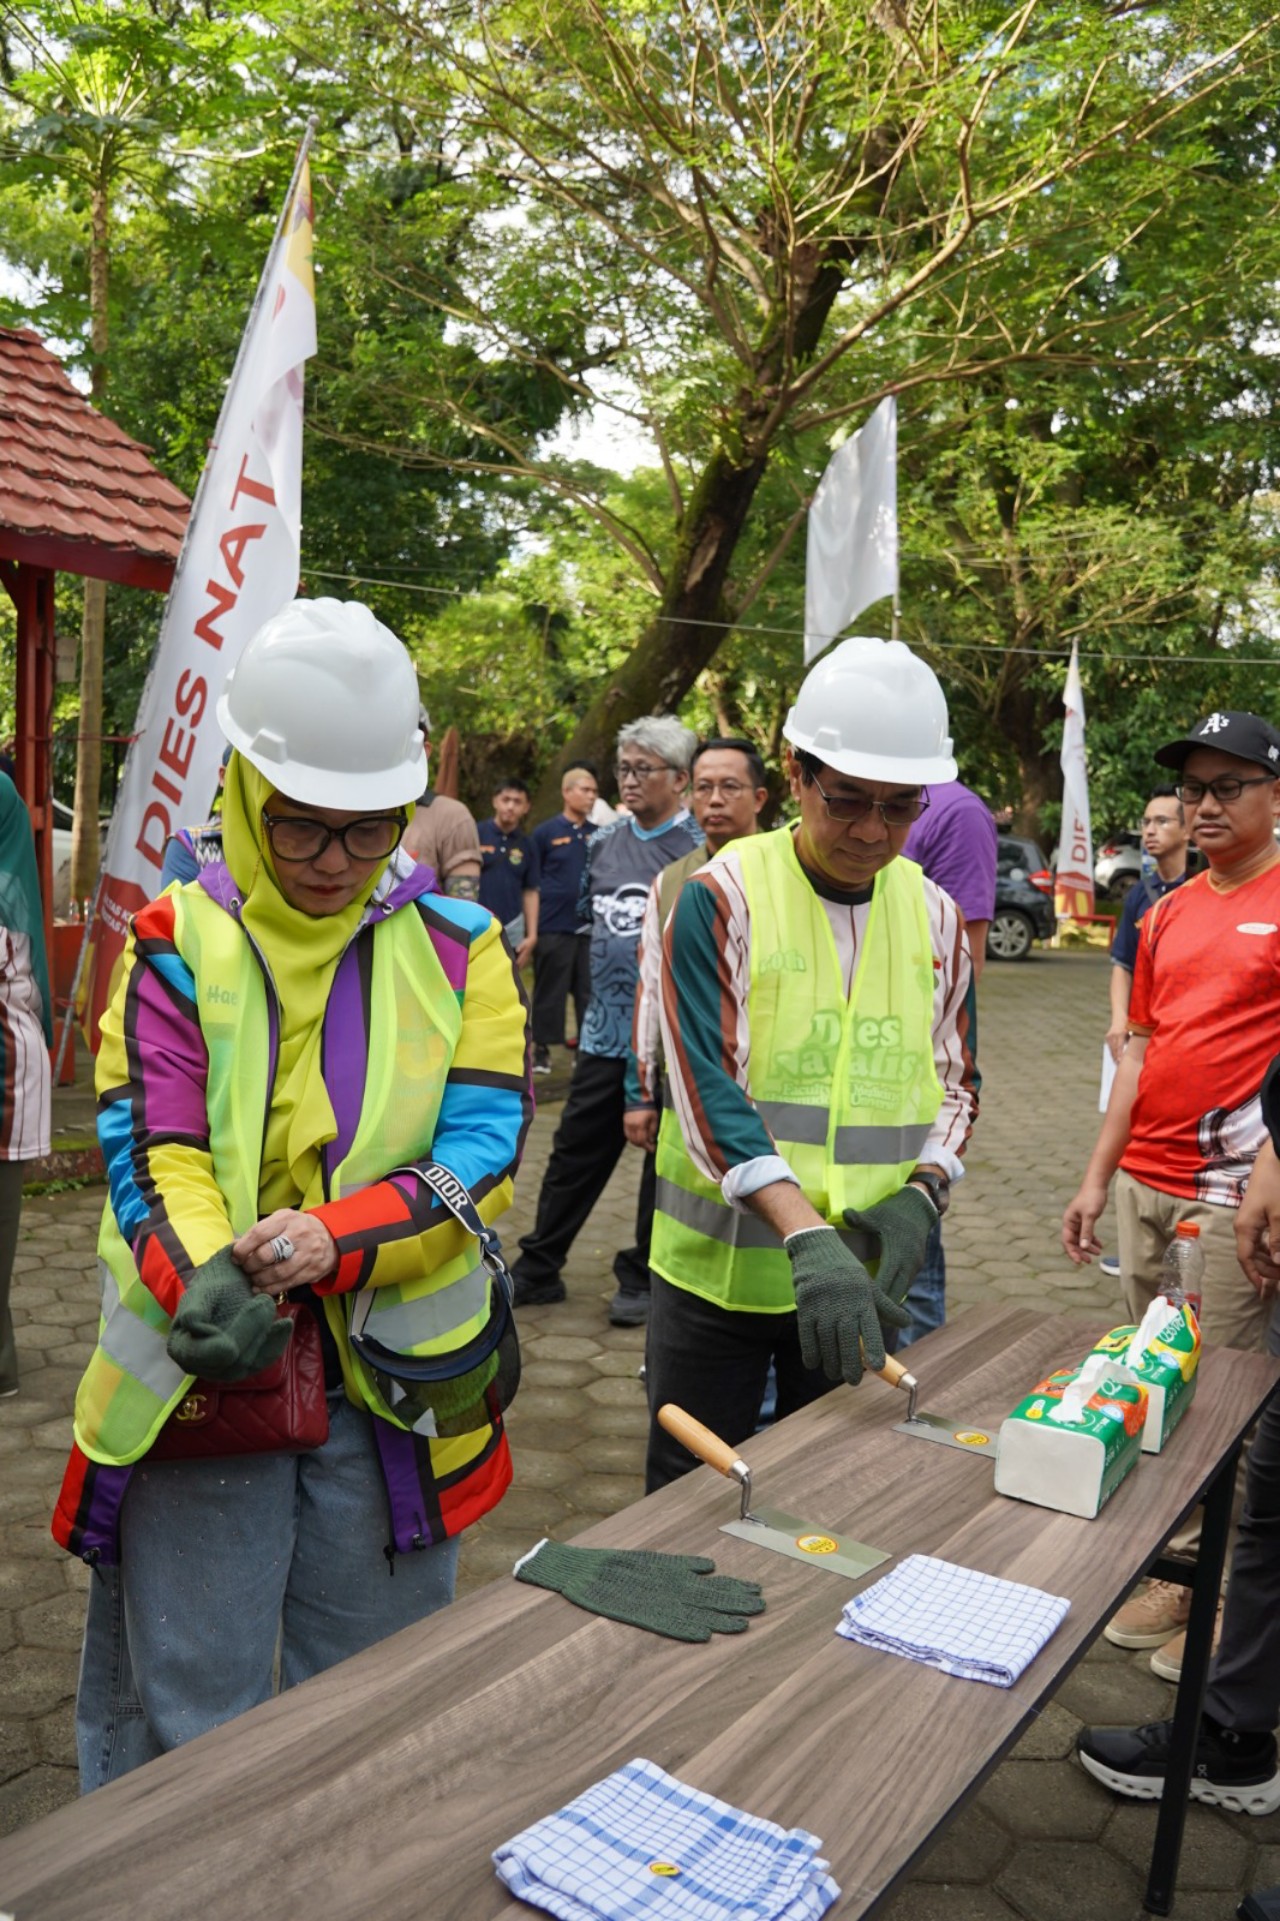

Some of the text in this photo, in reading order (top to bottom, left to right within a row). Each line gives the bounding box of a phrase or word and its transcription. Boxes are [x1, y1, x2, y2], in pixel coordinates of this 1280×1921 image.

[135, 668, 208, 871] DIES
[813, 1011, 902, 1049] Des
[770, 1048, 919, 1081] Naalis
[424, 1166, 468, 1210] DIOR
